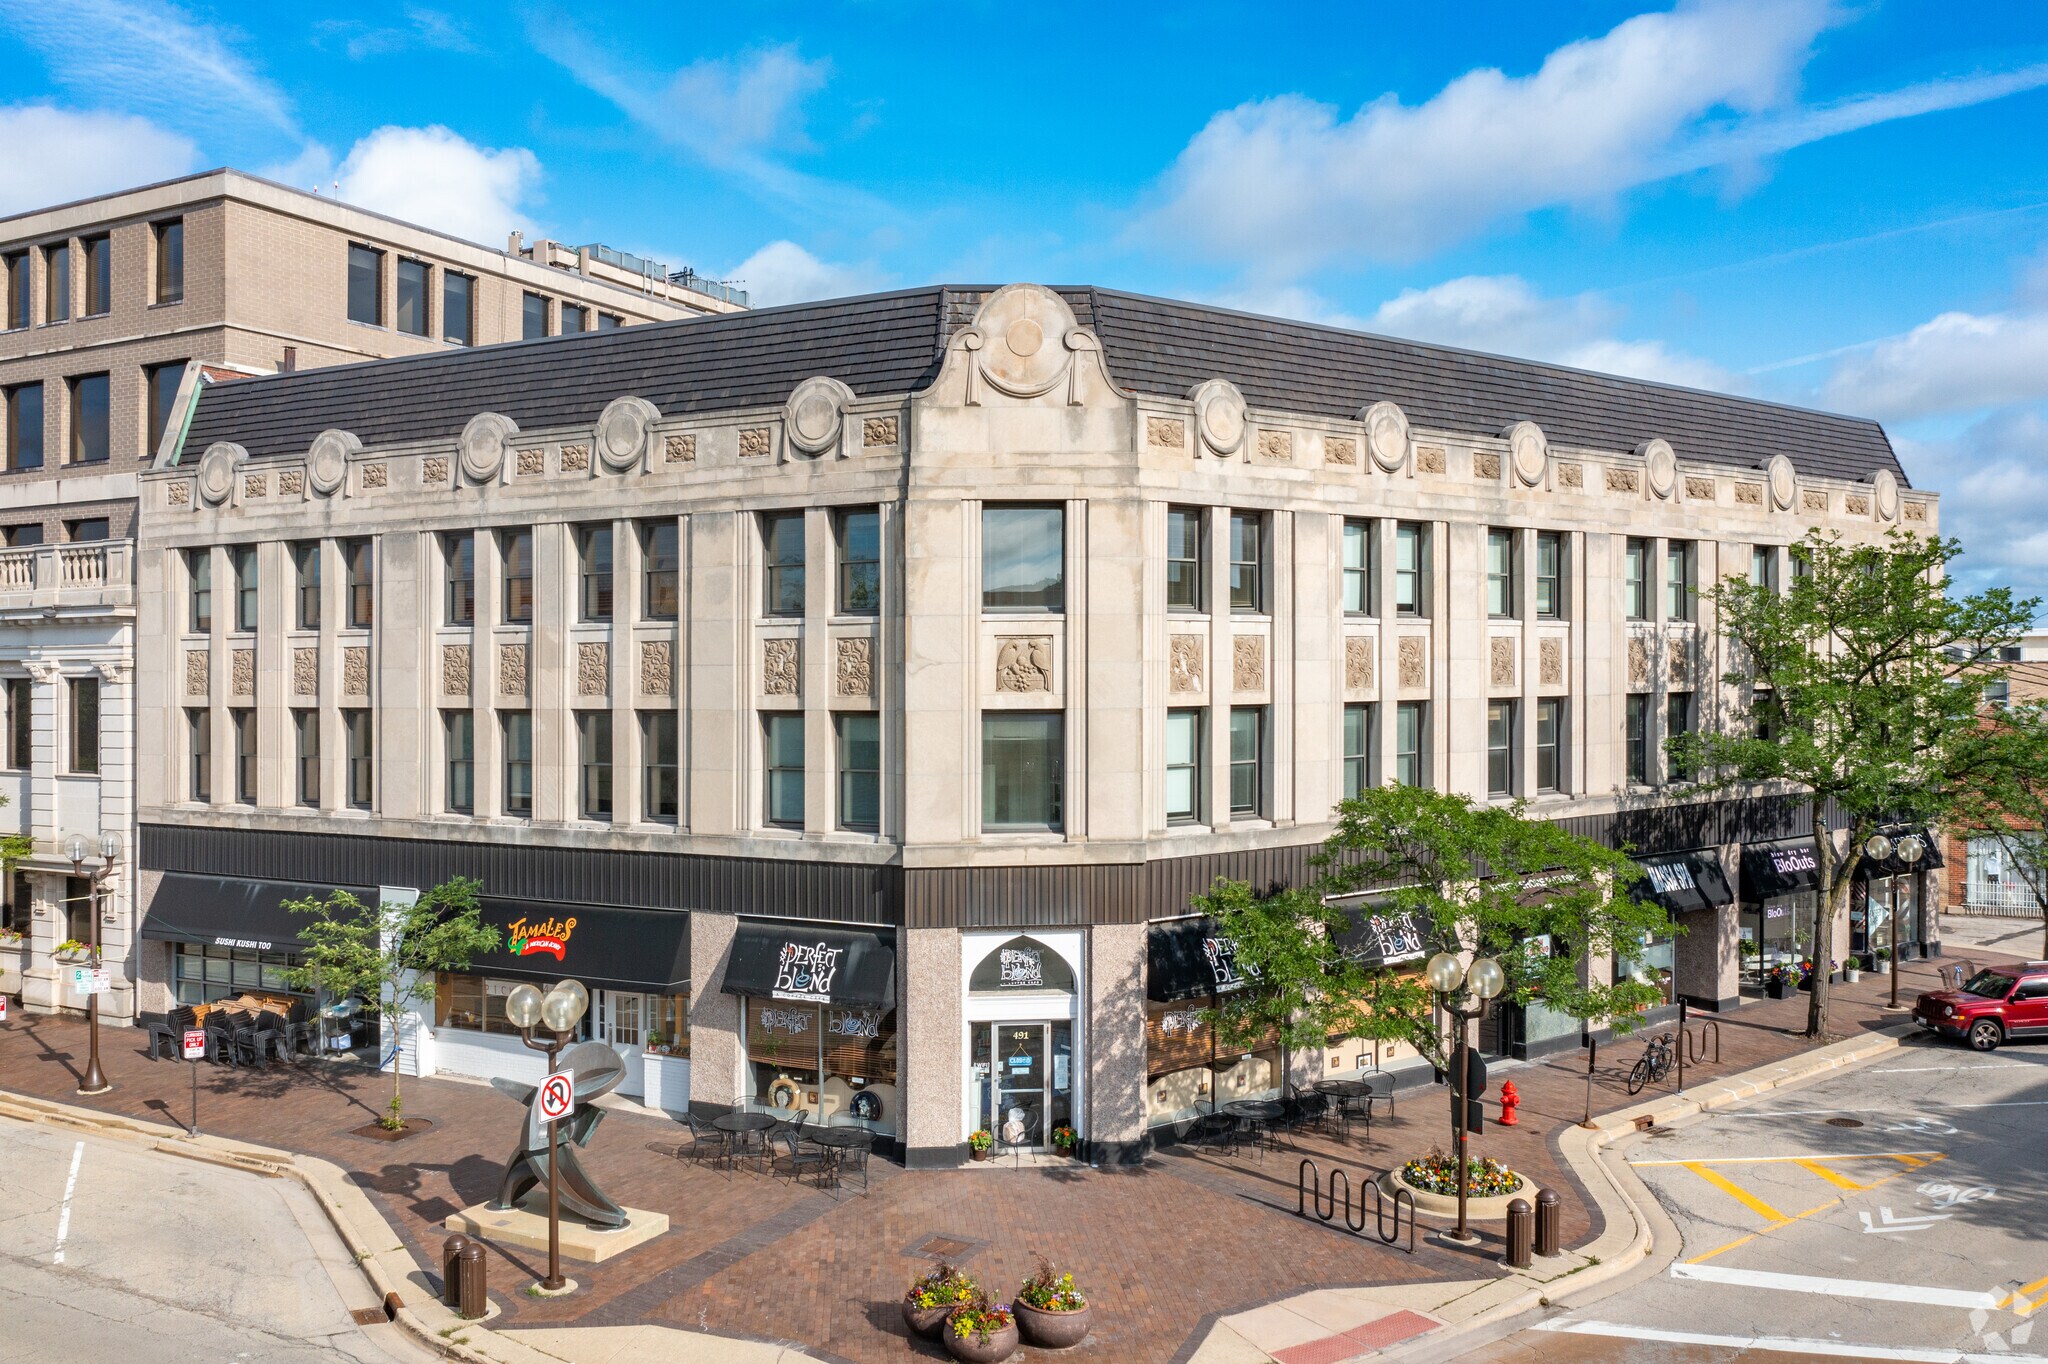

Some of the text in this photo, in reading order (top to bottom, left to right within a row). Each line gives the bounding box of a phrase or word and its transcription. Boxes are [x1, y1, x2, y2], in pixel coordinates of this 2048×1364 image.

[1774, 855, 1816, 873] BloOuts
[1647, 863, 1696, 893] MASSA SPA
[508, 917, 577, 953] TAMALES
[215, 937, 271, 949] SUSHI KUSHI TOO
[76, 971, 81, 979] 2
[1013, 1031, 1029, 1039] 491
